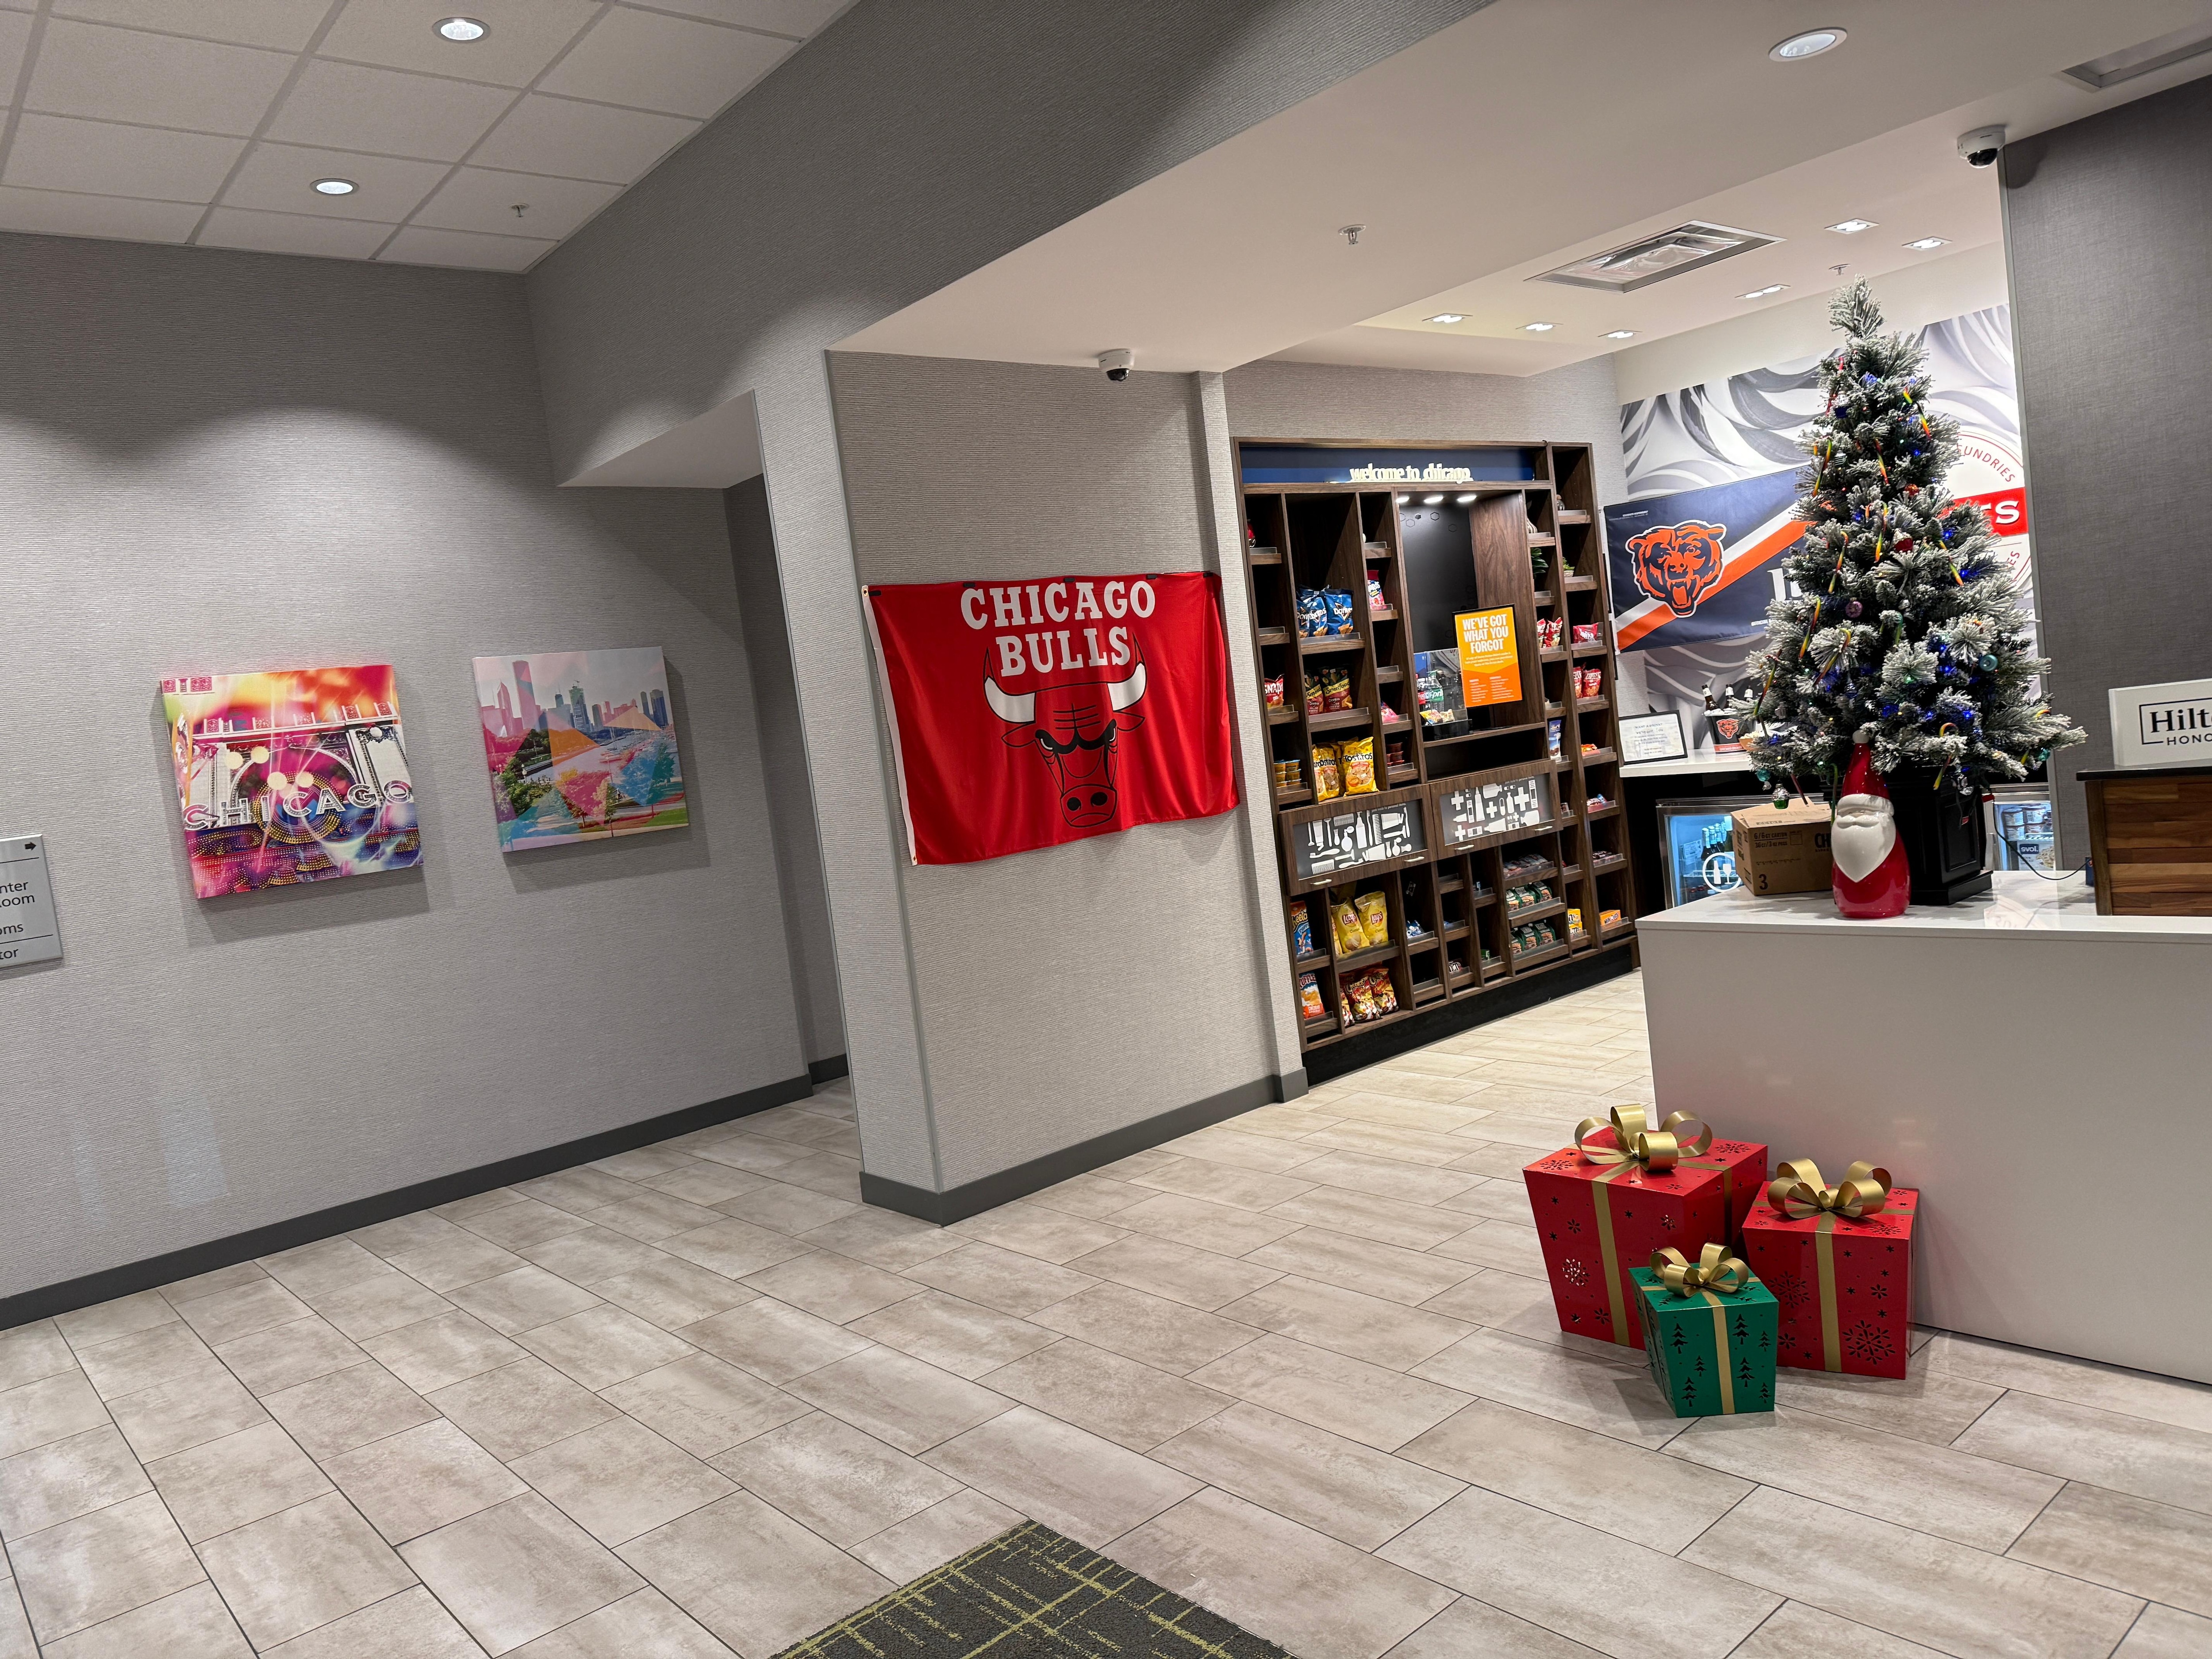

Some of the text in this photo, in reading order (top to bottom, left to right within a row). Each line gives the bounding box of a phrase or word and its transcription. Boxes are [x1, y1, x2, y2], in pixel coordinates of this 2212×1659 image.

[1349, 463, 1471, 484] welcome to chicago
[960, 580, 1156, 630] CHICAGO
[1462, 614, 1507, 631] WE'VE GOT
[1463, 626, 1509, 642] WHAT YOU
[995, 626, 1132, 677] BULLS
[1470, 638, 1504, 654] FORGOT
[2149, 708, 2212, 733] Hilt
[2167, 733, 2212, 745] HONO
[184, 780, 412, 830] CHICAGO
[1759, 874, 1768, 891] 3
[0, 895, 35, 908] oom
[1371, 912, 1382, 924] Lay's
[0, 924, 24, 935] ms
